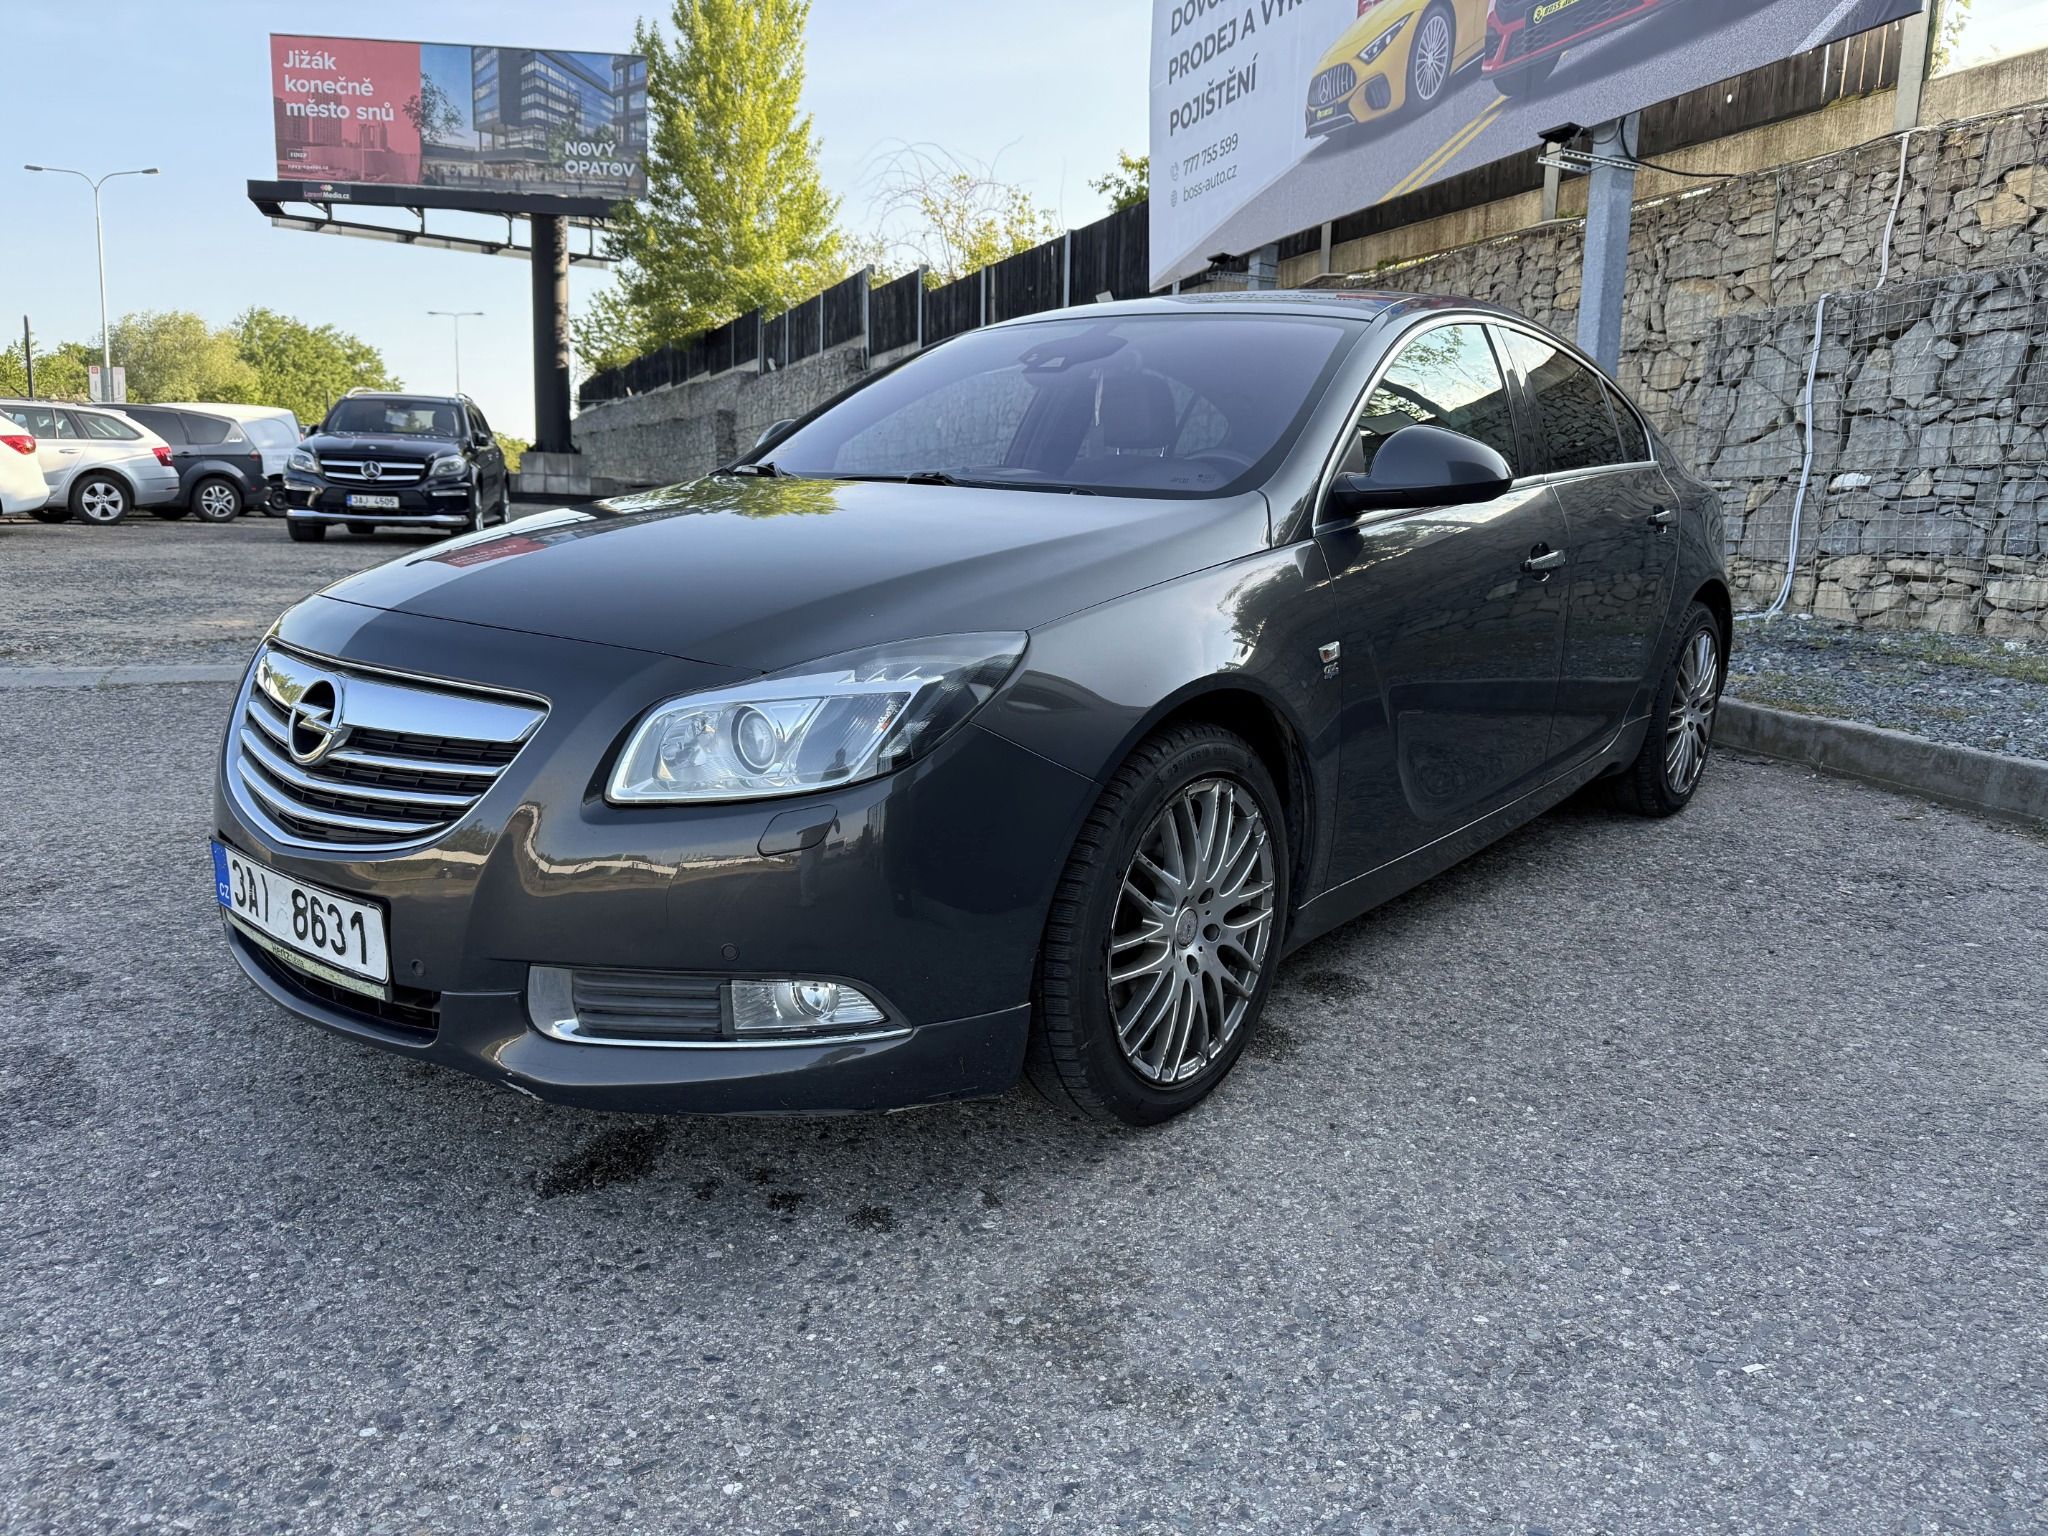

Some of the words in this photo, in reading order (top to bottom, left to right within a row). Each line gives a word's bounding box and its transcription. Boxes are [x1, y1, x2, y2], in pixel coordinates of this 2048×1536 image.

[1169, 17, 1237, 86] PRODEJ
[1241, 8, 1256, 40] A
[283, 50, 336, 70] Jižák
[284, 74, 374, 96] konečně
[1169, 52, 1258, 136] POJIŠTĚNÍ
[286, 98, 350, 119] město
[356, 102, 394, 121] snů
[565, 140, 616, 158] NOVÝ
[1183, 153, 1200, 176] 777
[1201, 143, 1218, 166] 755
[1219, 133, 1239, 157] 599
[564, 160, 636, 177] OPATOV
[1183, 164, 1238, 202] boss-auto.cz
[353, 496, 369, 505] 3AJ
[374, 496, 396, 506] 4505
[219, 881, 230, 900] CZ
[232, 859, 269, 923] 3AI
[291, 888, 367, 965] 8631
